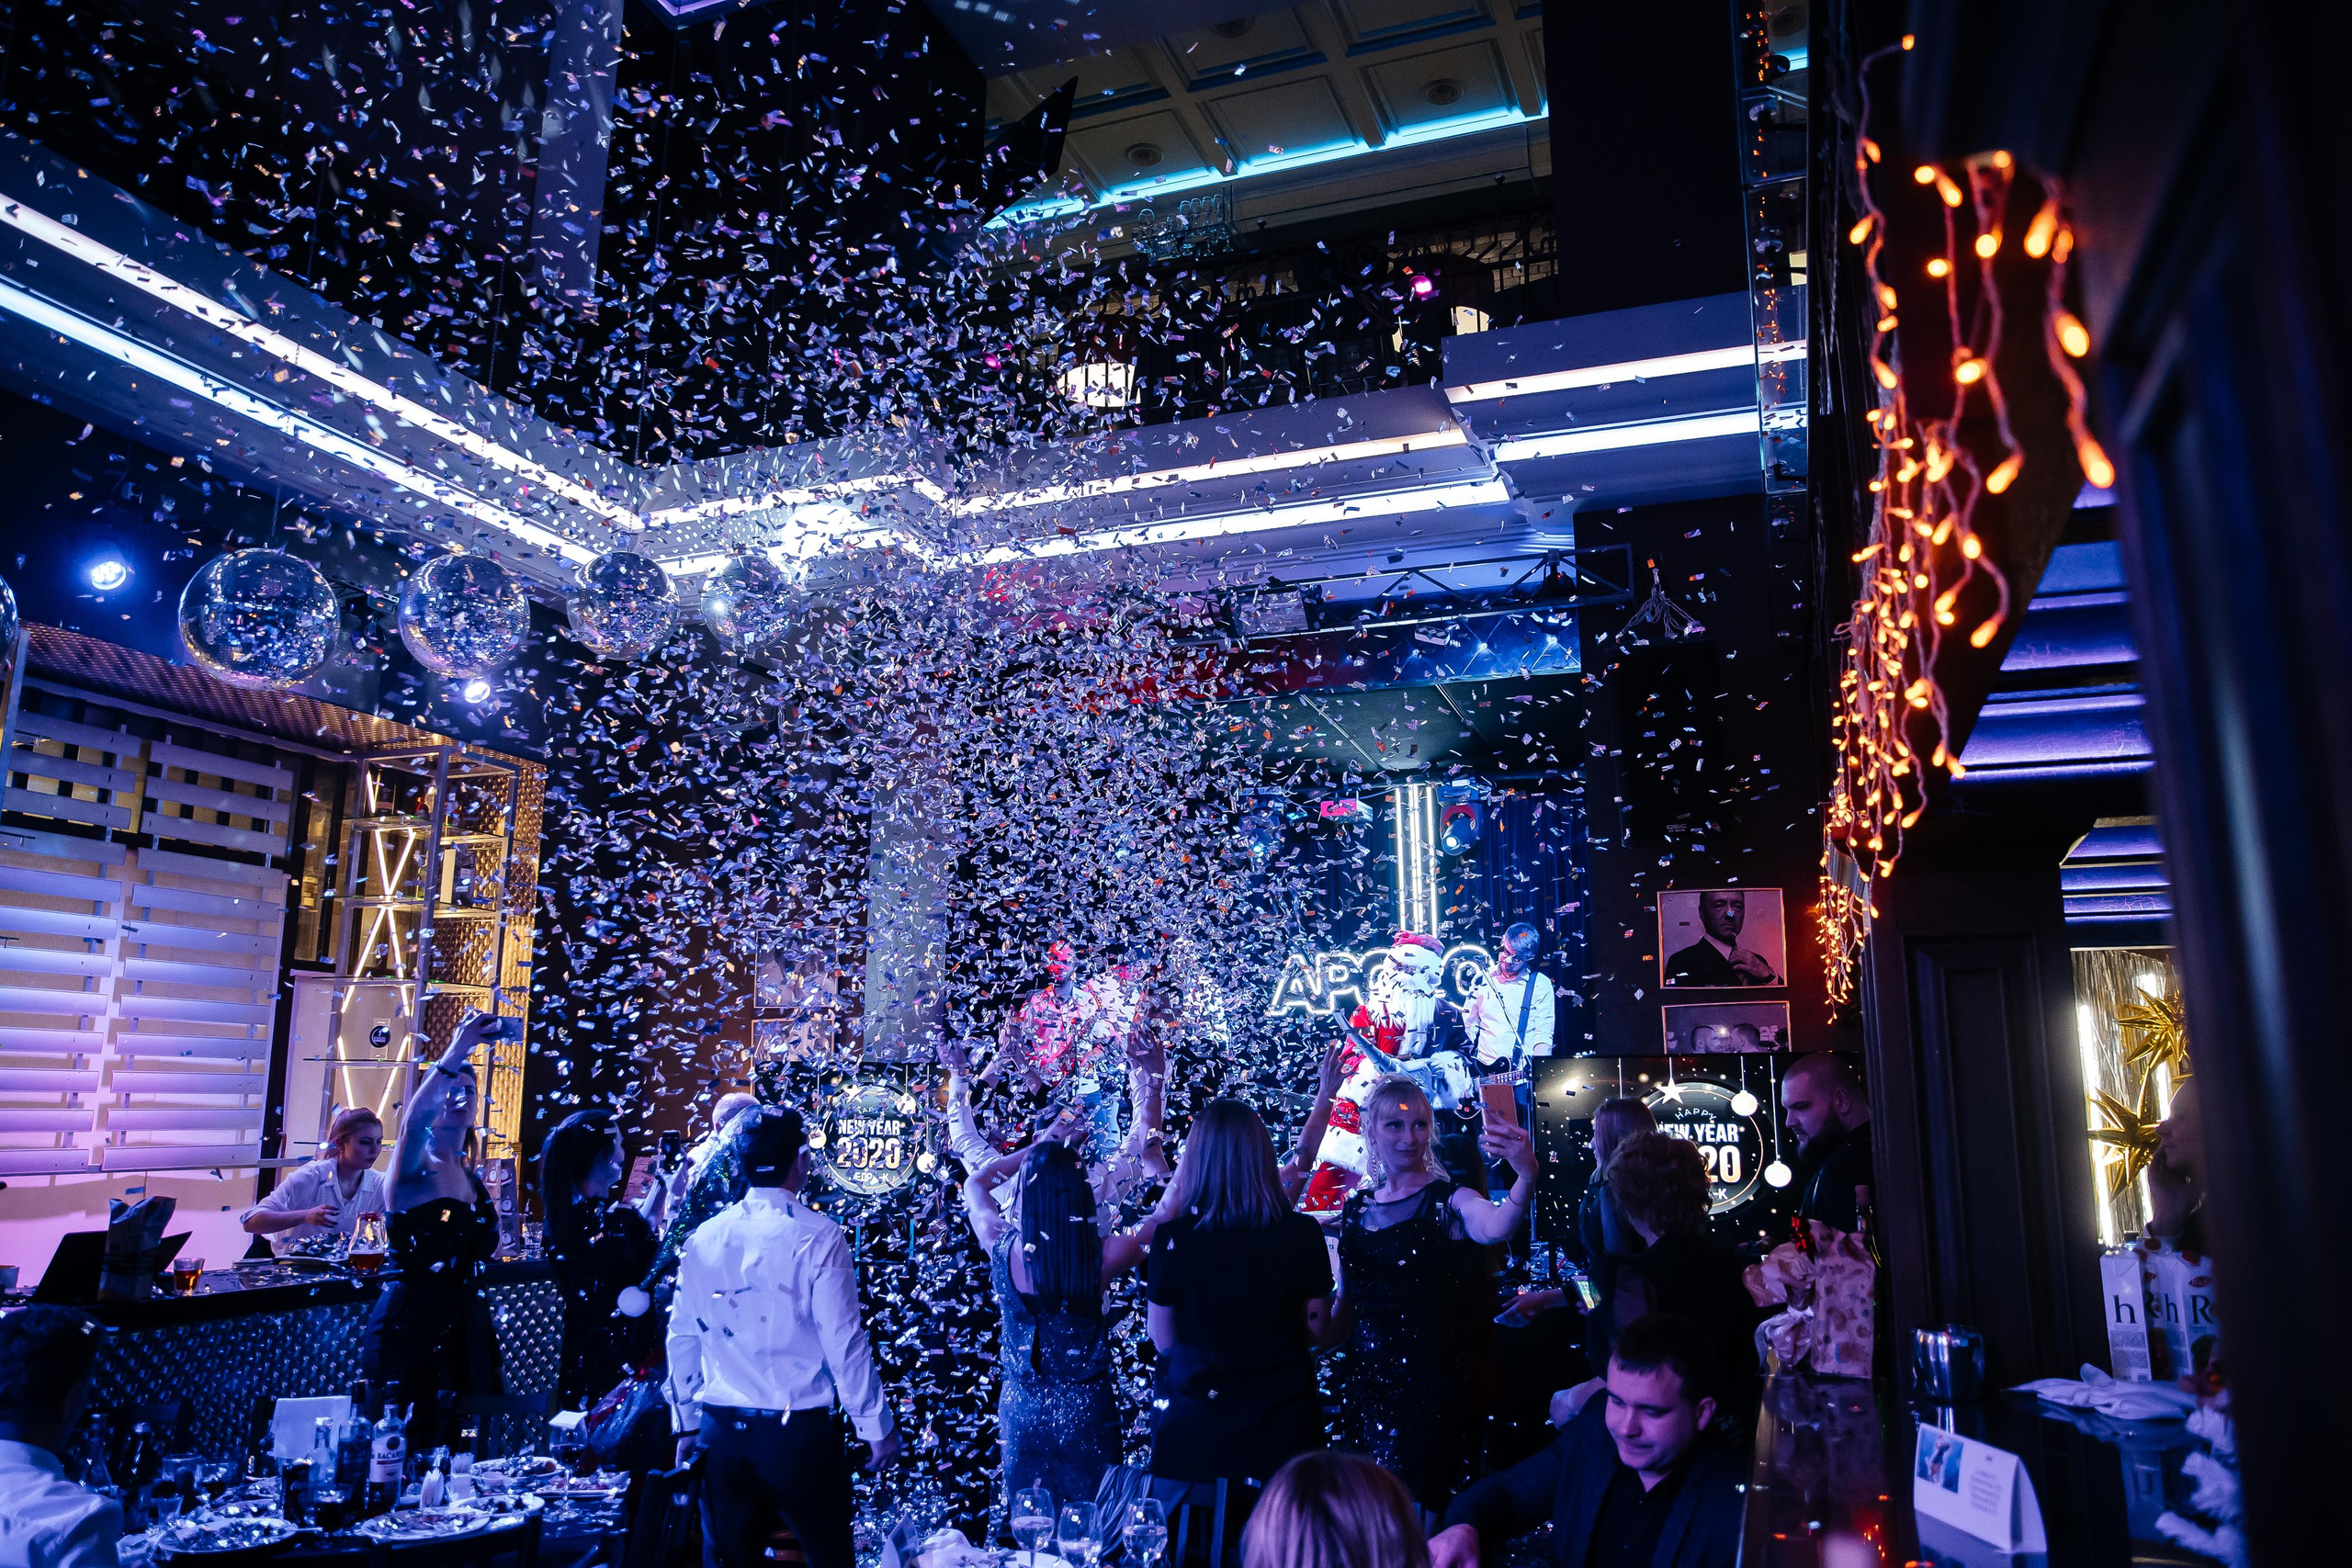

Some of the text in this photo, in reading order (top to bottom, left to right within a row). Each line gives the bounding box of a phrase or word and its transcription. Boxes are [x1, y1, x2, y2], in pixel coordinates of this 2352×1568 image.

[838, 1119, 900, 1135] NEW YEAR
[1674, 1108, 1717, 1121] HAPPY
[1693, 1123, 1740, 1143] YEAR
[837, 1137, 901, 1169] 2020
[2112, 1294, 2137, 1324] h
[2165, 1293, 2179, 1323] h
[2191, 1294, 2213, 1324] R
